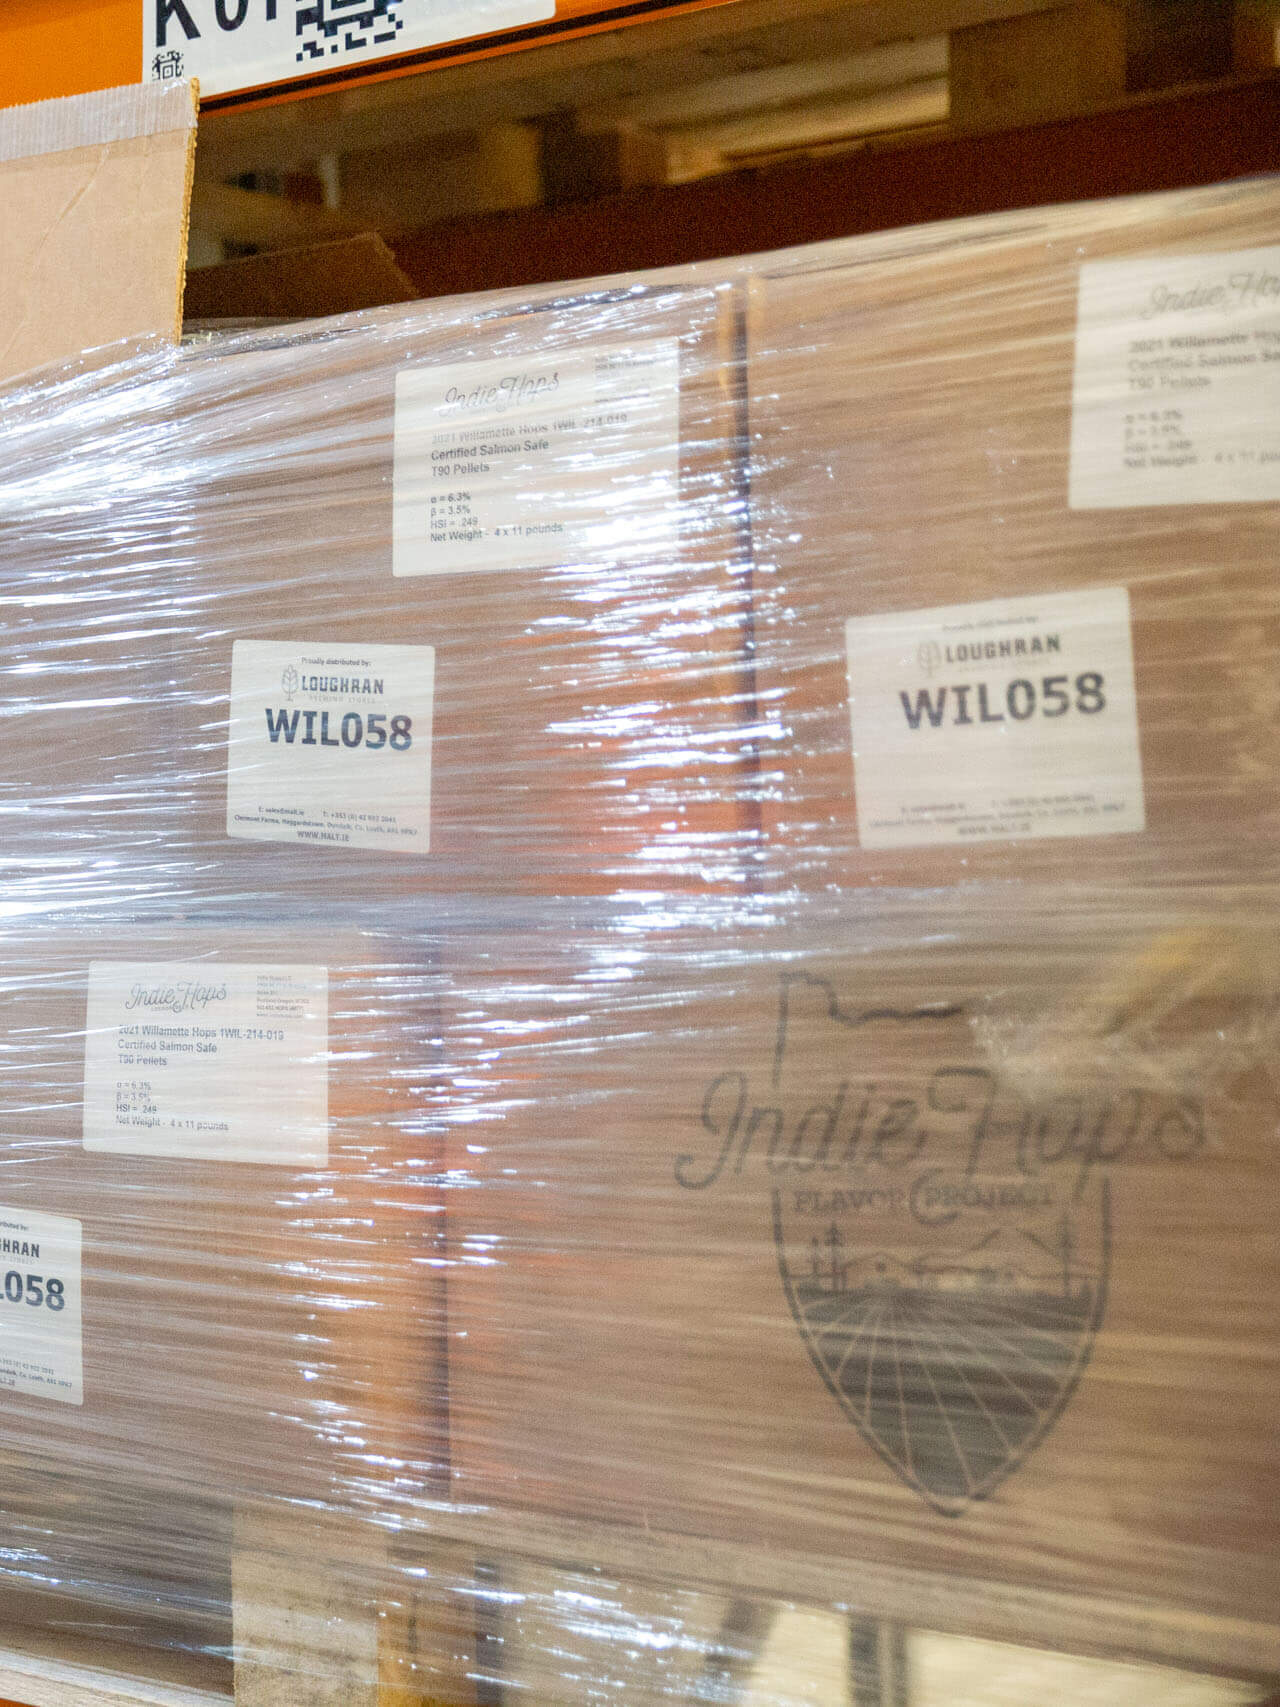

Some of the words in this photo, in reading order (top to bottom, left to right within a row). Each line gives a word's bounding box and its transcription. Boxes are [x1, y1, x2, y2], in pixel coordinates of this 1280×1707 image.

[431, 445, 478, 461] Certified
[480, 442, 521, 456] Salmon
[523, 438, 549, 452] Safe
[432, 464, 450, 477] T90
[453, 462, 490, 475] Pellets
[430, 531, 446, 542] Net
[448, 529, 483, 541] Weight
[494, 528, 500, 537] 4
[525, 522, 564, 537] pounds
[945, 634, 1061, 664] LOUGHRAN
[301, 675, 384, 695] LOUGHRAN
[899, 671, 1107, 730] WIL058
[265, 708, 413, 751] WIL058
[125, 982, 176, 1010] Indie
[176, 980, 228, 1011] Hops
[142, 1025, 189, 1037] Willamette
[192, 1026, 216, 1039] Hops
[118, 1038, 157, 1050] Certified
[160, 1040, 194, 1052] Salmon
[196, 1041, 218, 1053] Safe
